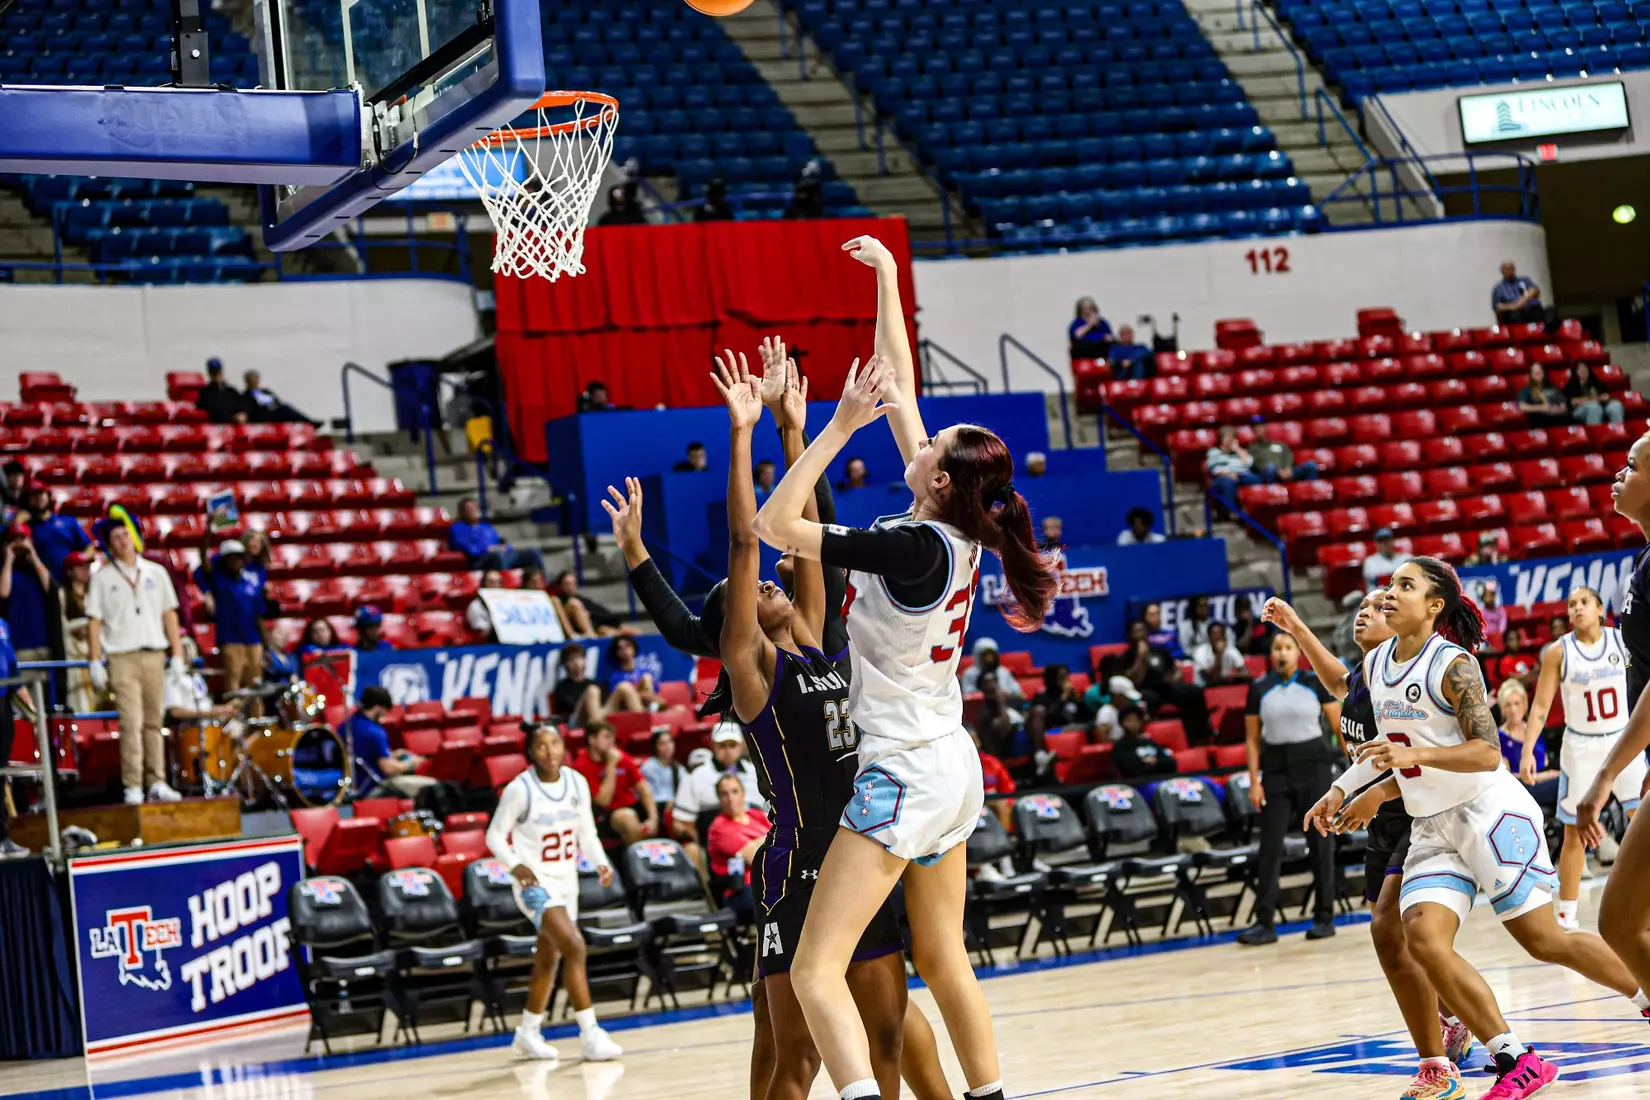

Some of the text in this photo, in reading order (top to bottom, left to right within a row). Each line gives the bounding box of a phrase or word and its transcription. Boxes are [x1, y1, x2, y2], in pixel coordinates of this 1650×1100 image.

[1244, 247, 1291, 274] 112
[1583, 687, 1619, 723] 10
[824, 698, 855, 751] 23
[1340, 715, 1366, 742] SUA
[541, 829, 574, 863] 22
[187, 860, 281, 949] HOOP
